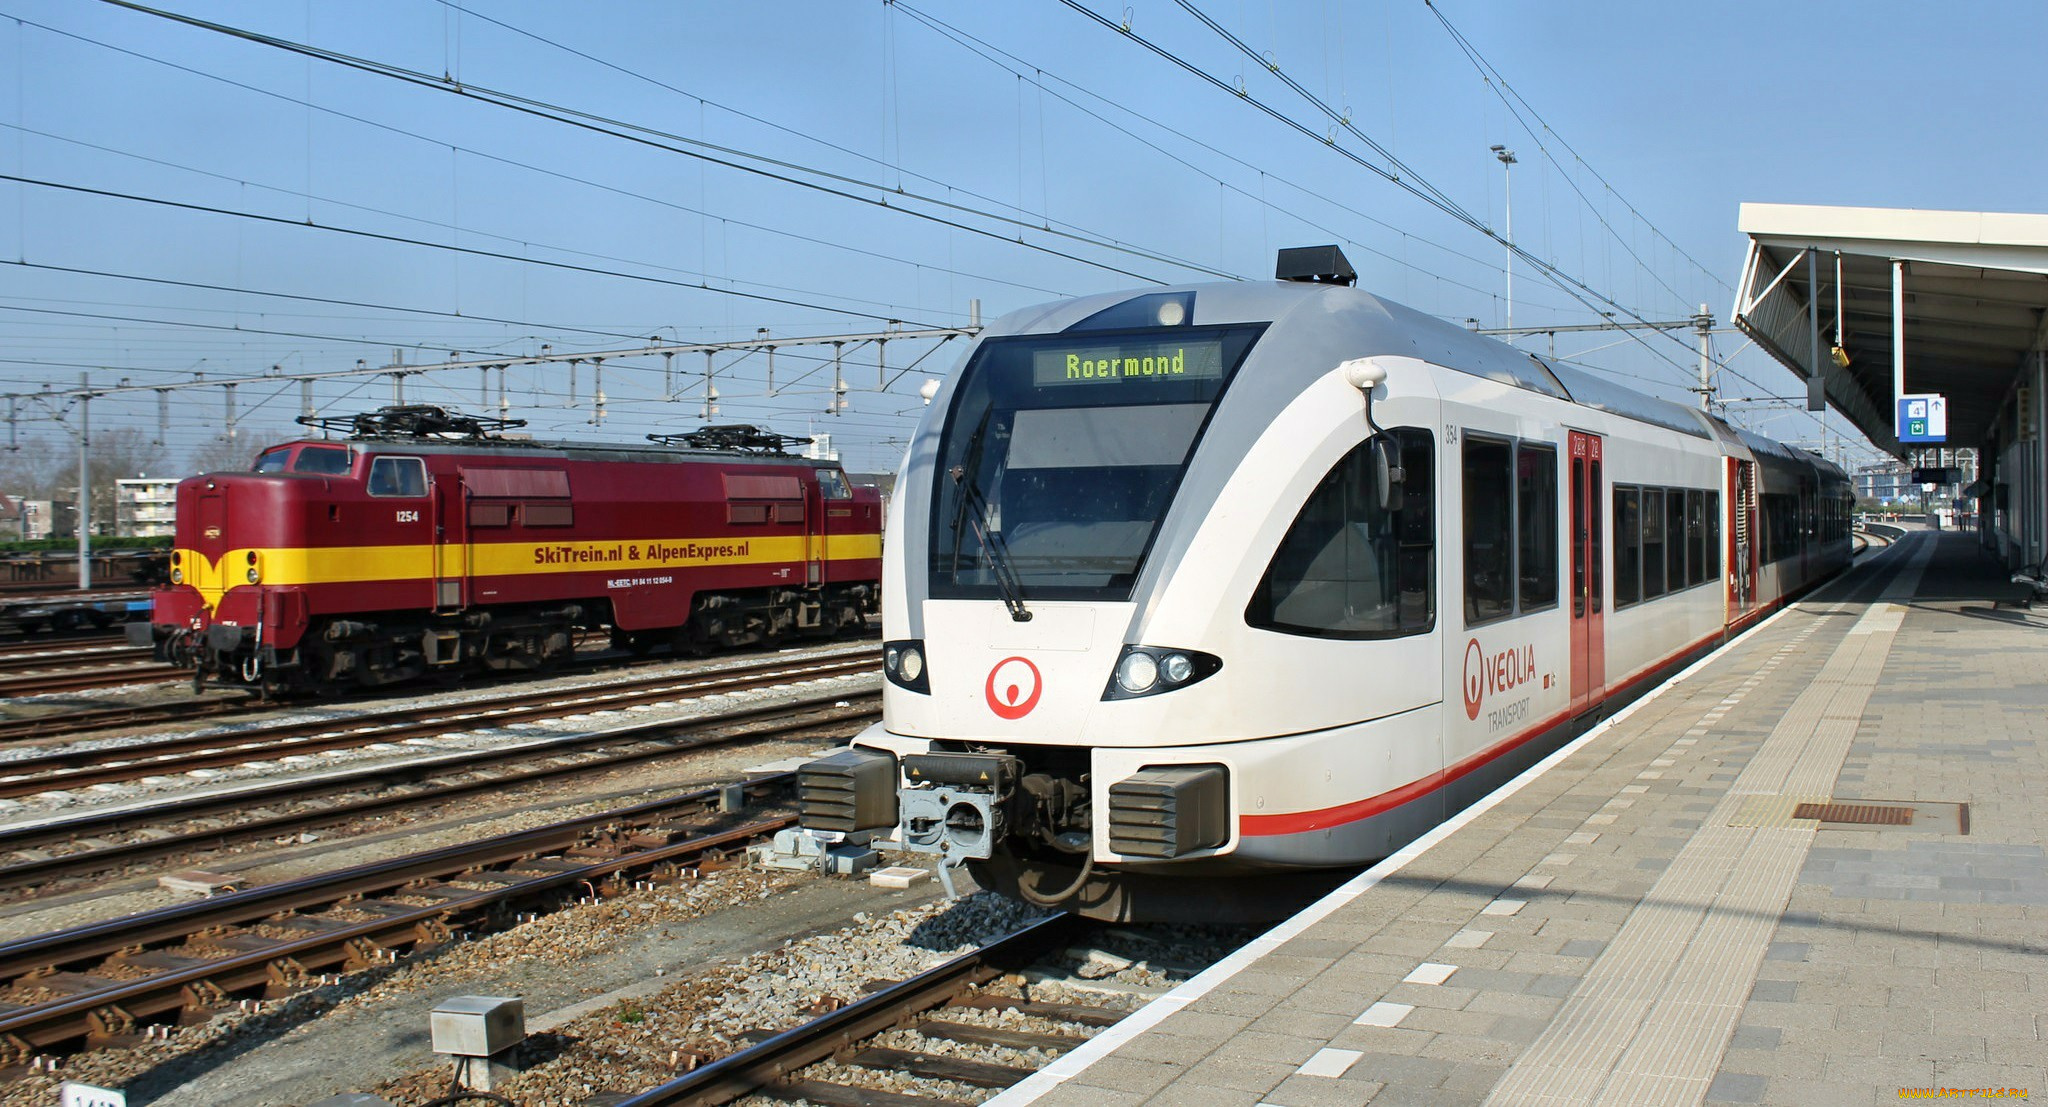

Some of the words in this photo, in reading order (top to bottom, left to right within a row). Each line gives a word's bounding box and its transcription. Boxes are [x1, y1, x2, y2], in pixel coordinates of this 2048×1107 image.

[1066, 348, 1184, 379] Roermond
[1445, 424, 1458, 445] 354
[396, 510, 419, 522] 1254
[535, 545, 623, 564] SkiTrein.nl
[628, 545, 640, 560] &
[646, 541, 749, 563] AlpenExpres.nl
[1486, 644, 1536, 696] VEOLIA
[1488, 697, 1530, 733] TRANSPORT
